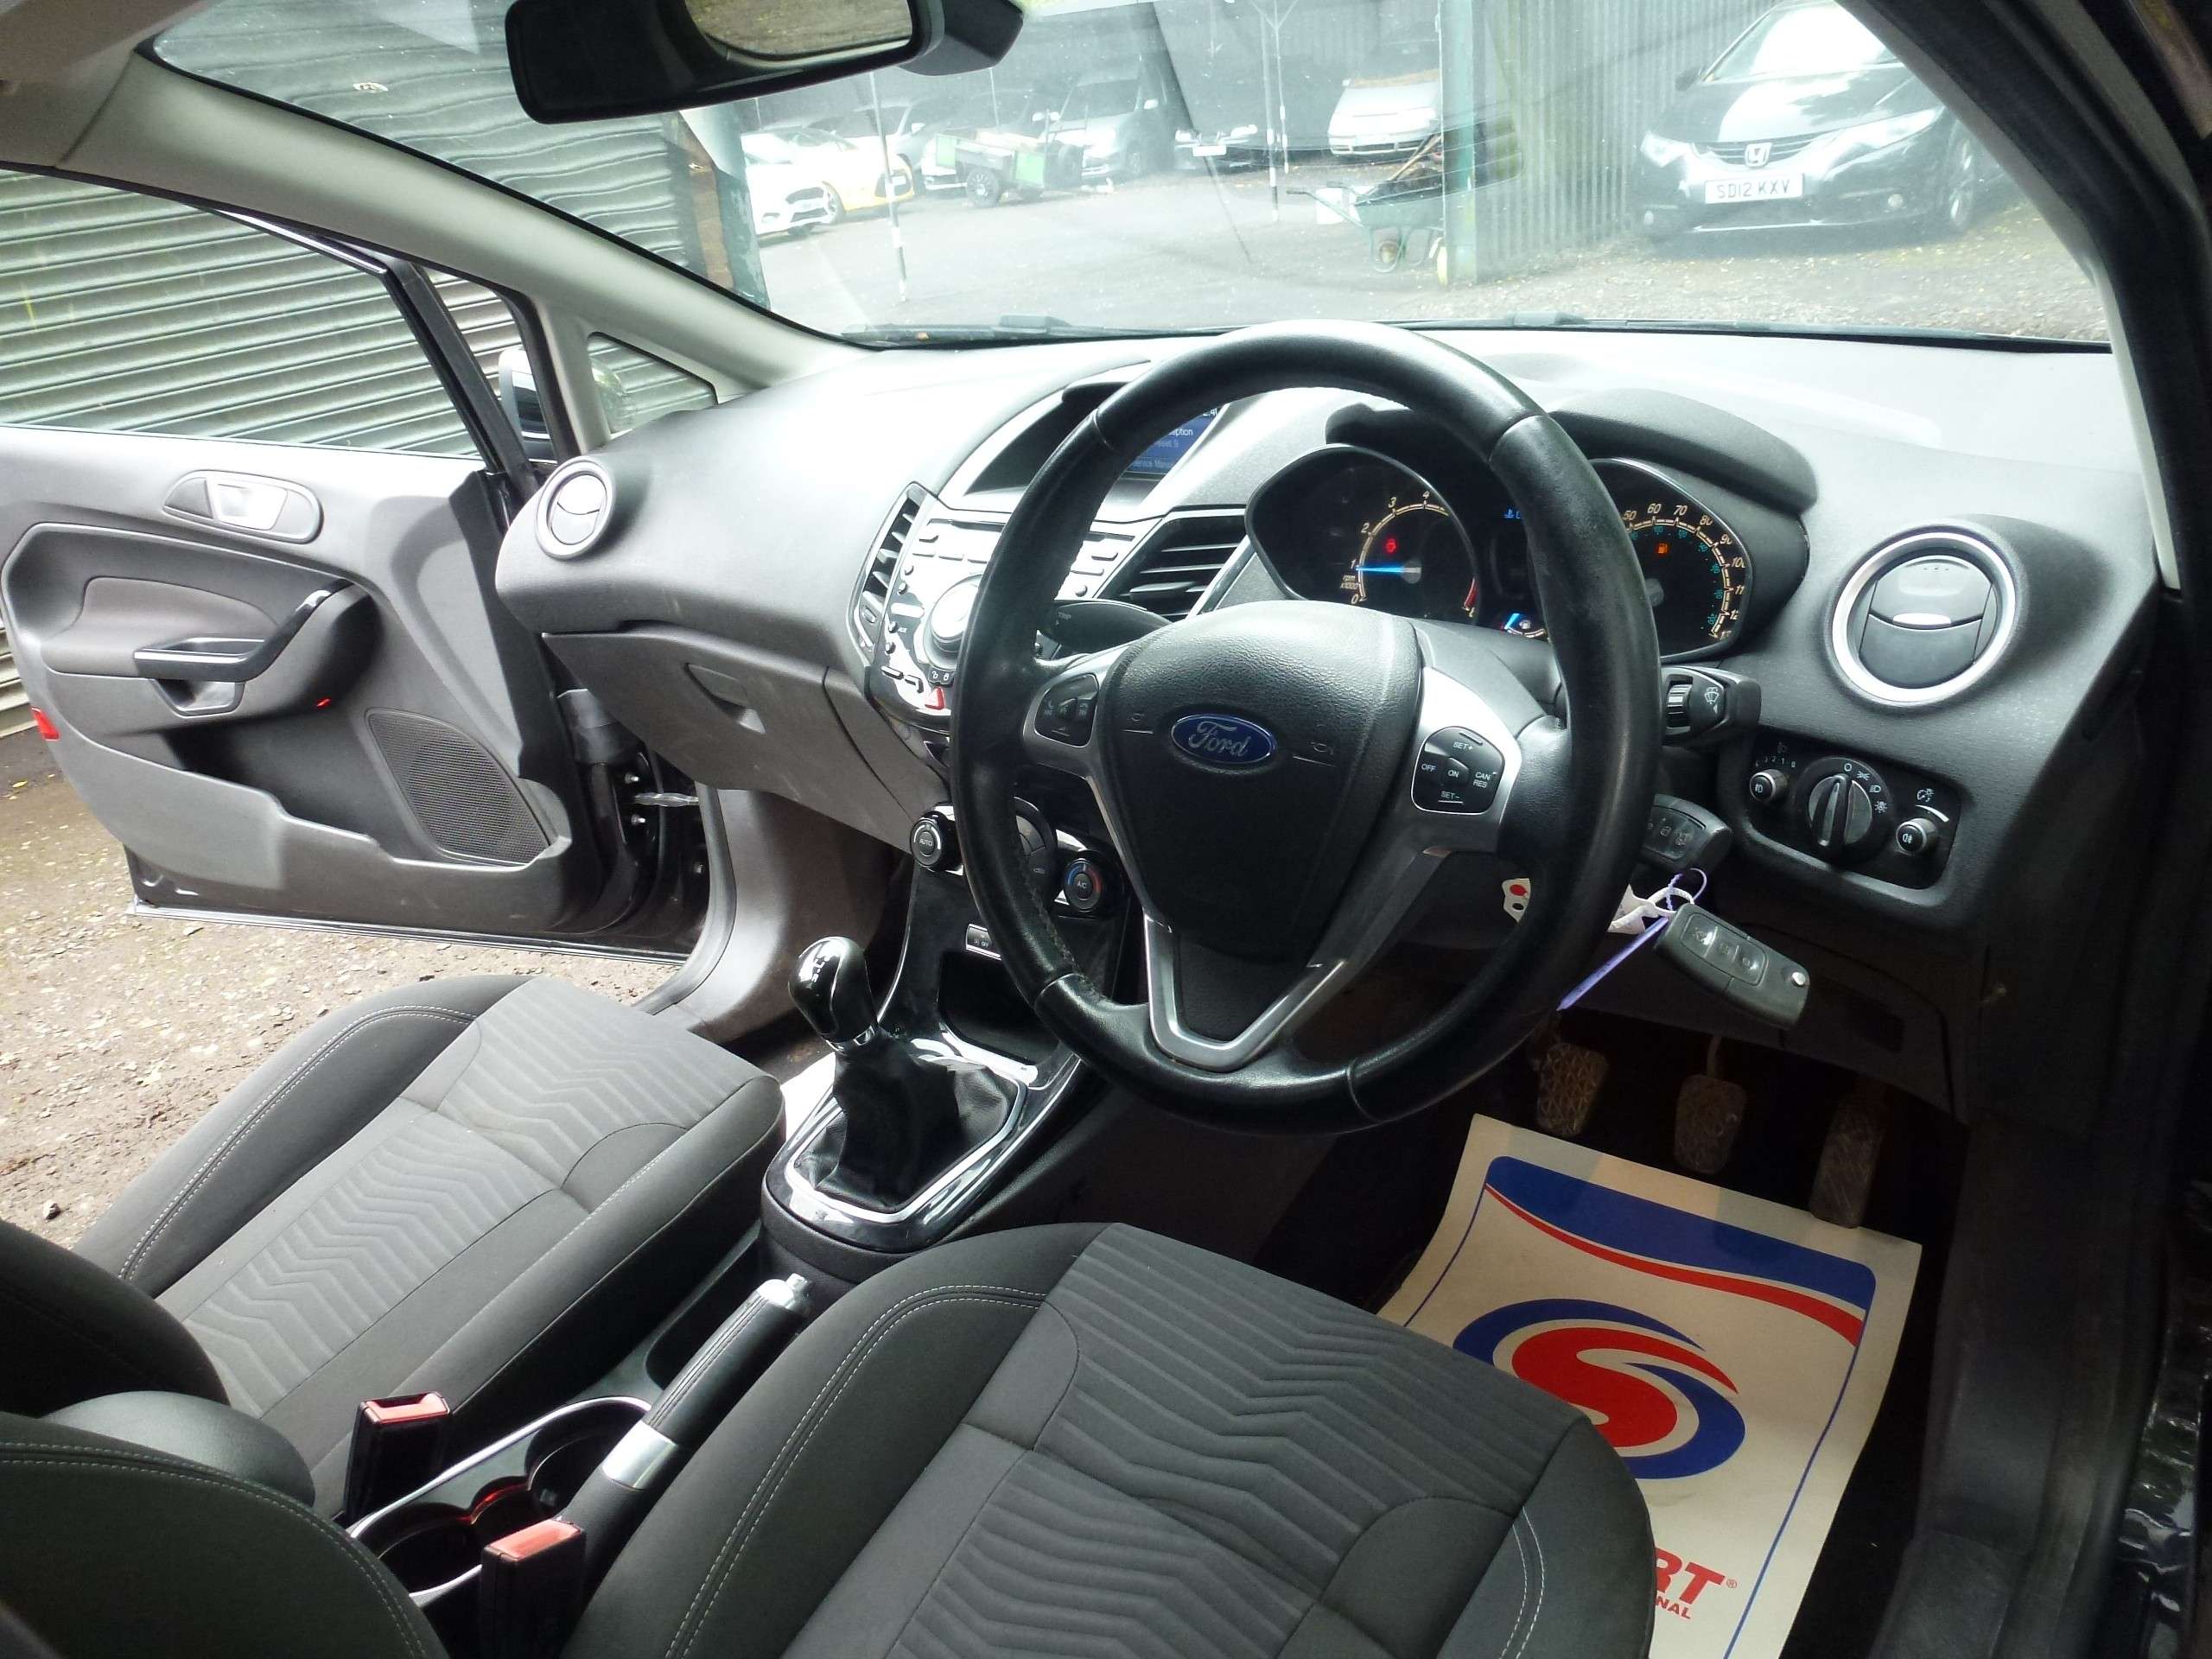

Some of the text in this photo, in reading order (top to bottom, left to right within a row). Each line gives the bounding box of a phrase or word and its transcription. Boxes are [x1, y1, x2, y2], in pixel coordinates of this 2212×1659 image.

[1716, 179, 1790, 199] SD12 KXV
[1388, 496, 1397, 508] 3
[1647, 503, 1662, 514] 60
[1674, 505, 1688, 516] 70
[1361, 522, 1370, 533] 2
[1351, 593, 1359, 605] 0
[1187, 720, 1251, 758] Ford
[1421, 763, 1436, 772] OFF
[1475, 771, 1491, 780] CAN
[1472, 779, 1488, 788] RES
[919, 838, 933, 847] AUTO
